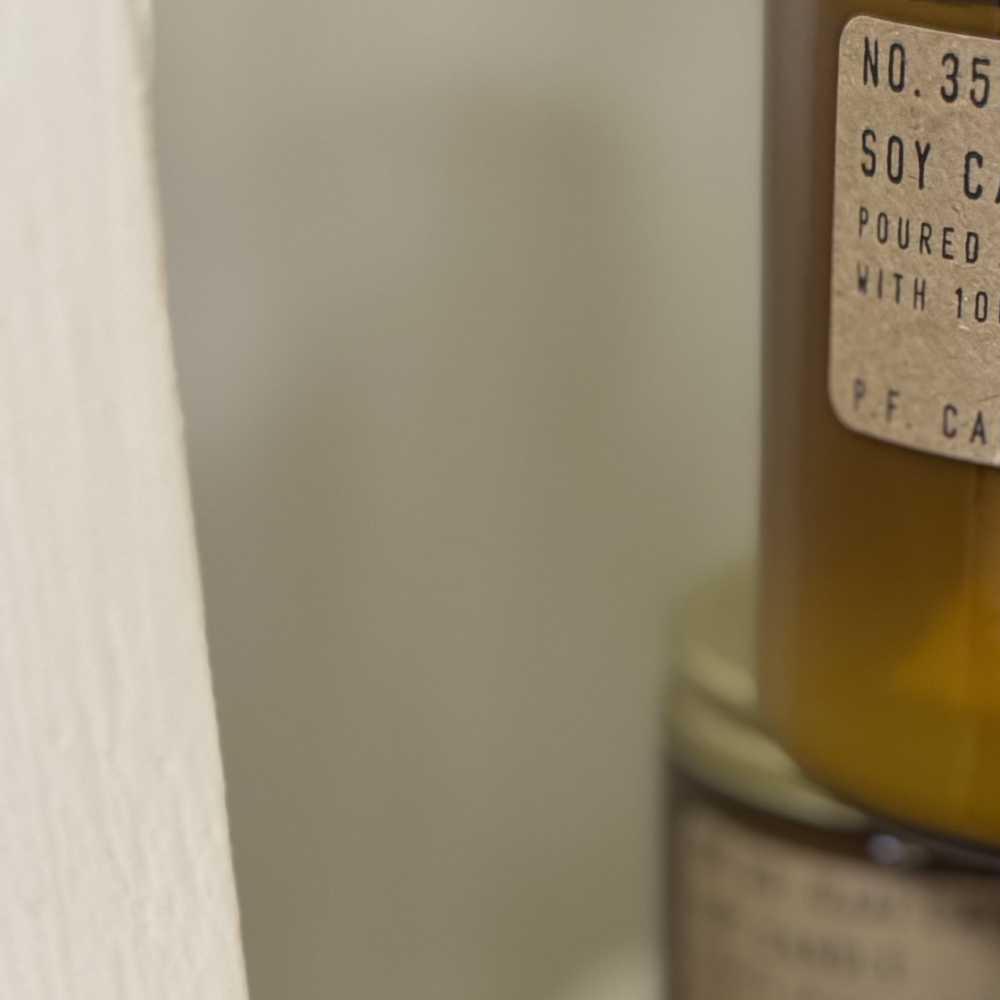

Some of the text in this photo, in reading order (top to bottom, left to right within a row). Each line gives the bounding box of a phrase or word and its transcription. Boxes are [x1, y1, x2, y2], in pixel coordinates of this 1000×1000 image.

[862, 36, 922, 99] NO.
[860, 129, 931, 190] SOY
[857, 207, 981, 265] POURED
[856, 264, 927, 312] WITH
